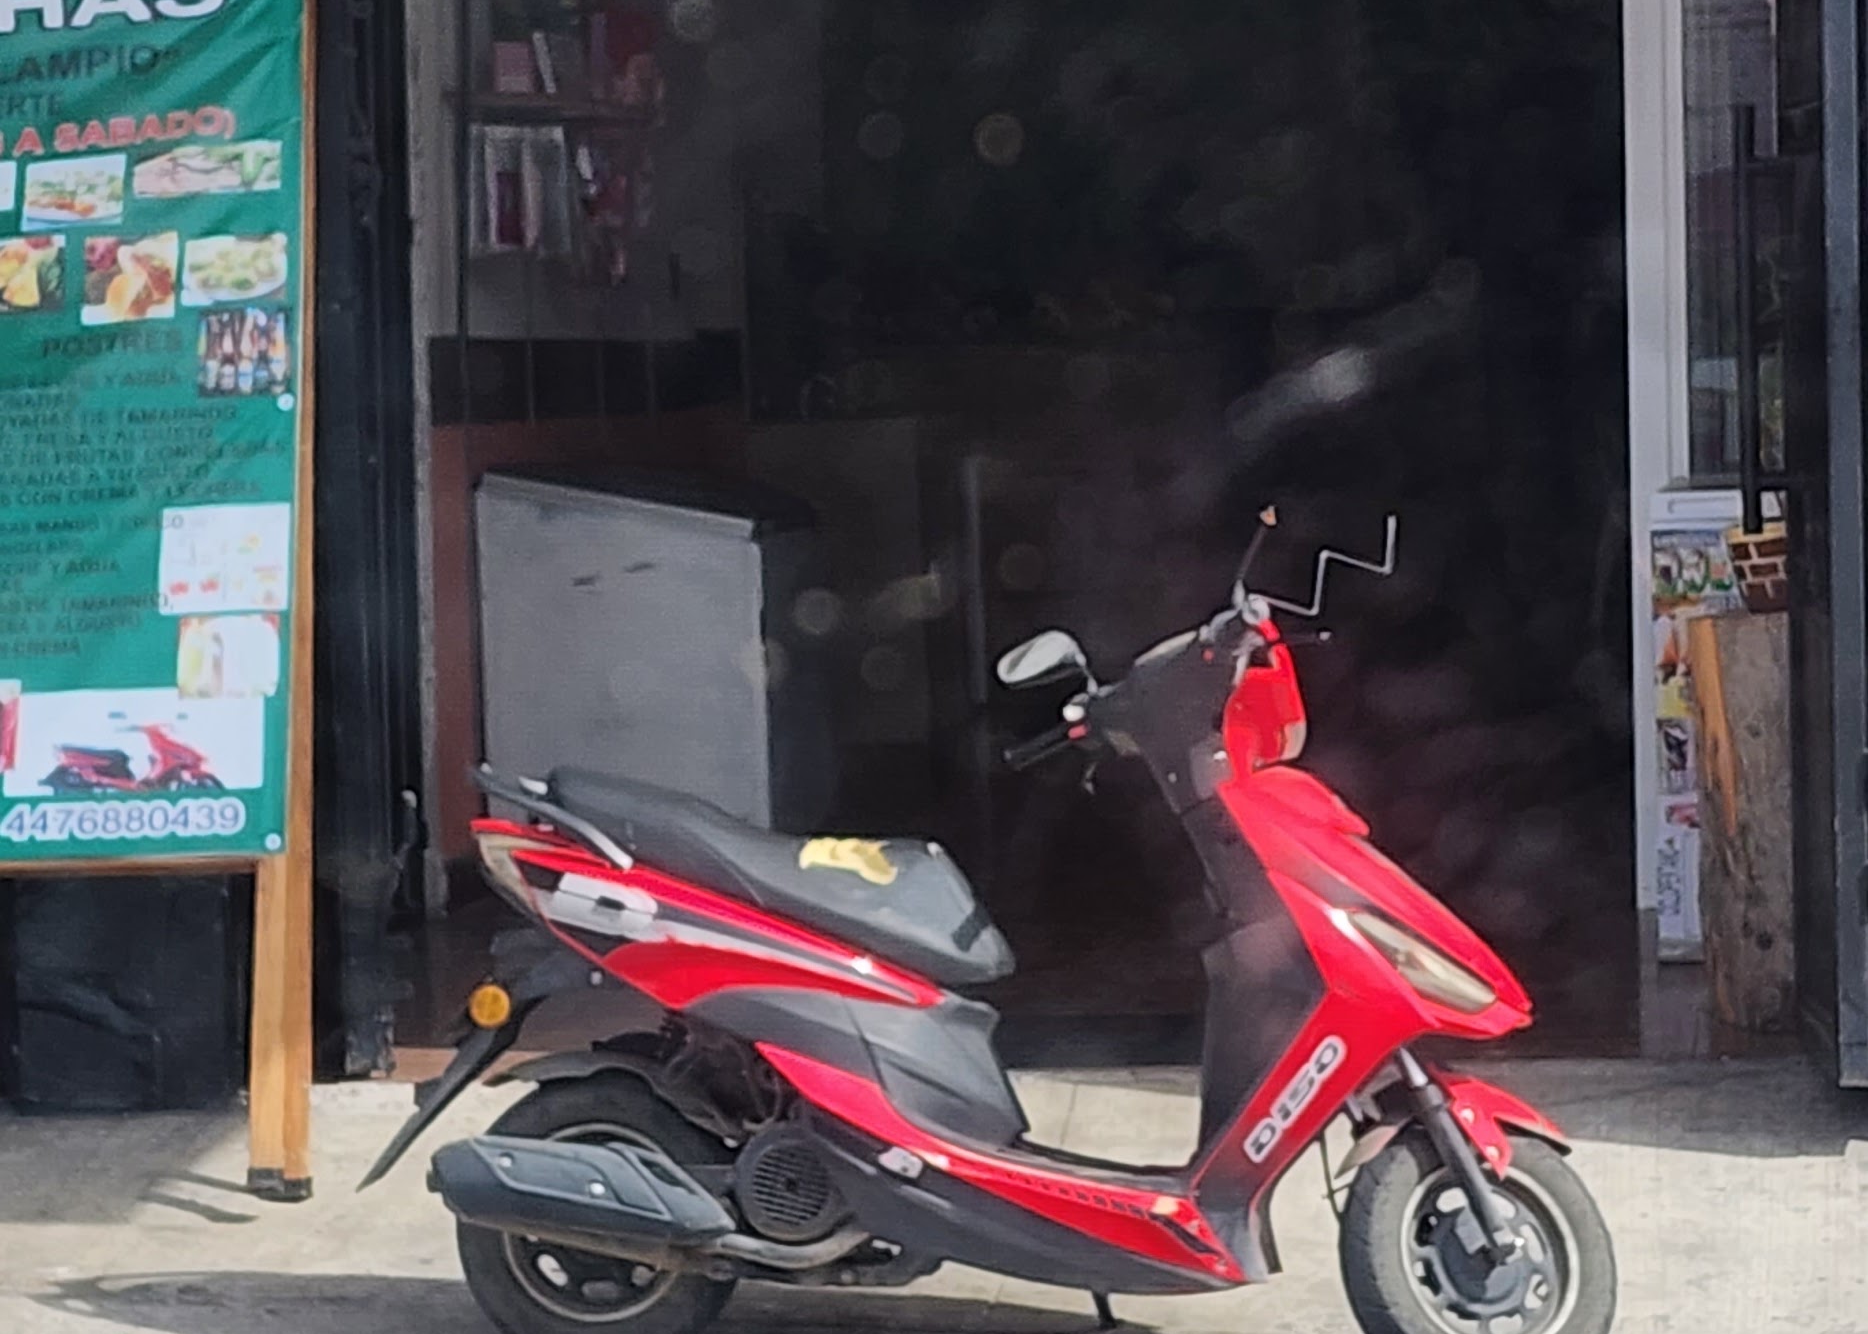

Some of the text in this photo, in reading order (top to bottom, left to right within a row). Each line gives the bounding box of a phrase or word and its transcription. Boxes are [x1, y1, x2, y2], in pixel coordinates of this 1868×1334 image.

[12, 126, 44, 157] A
[54, 106, 235, 153] SABADO)
[4, 802, 241, 838] 4476880439
